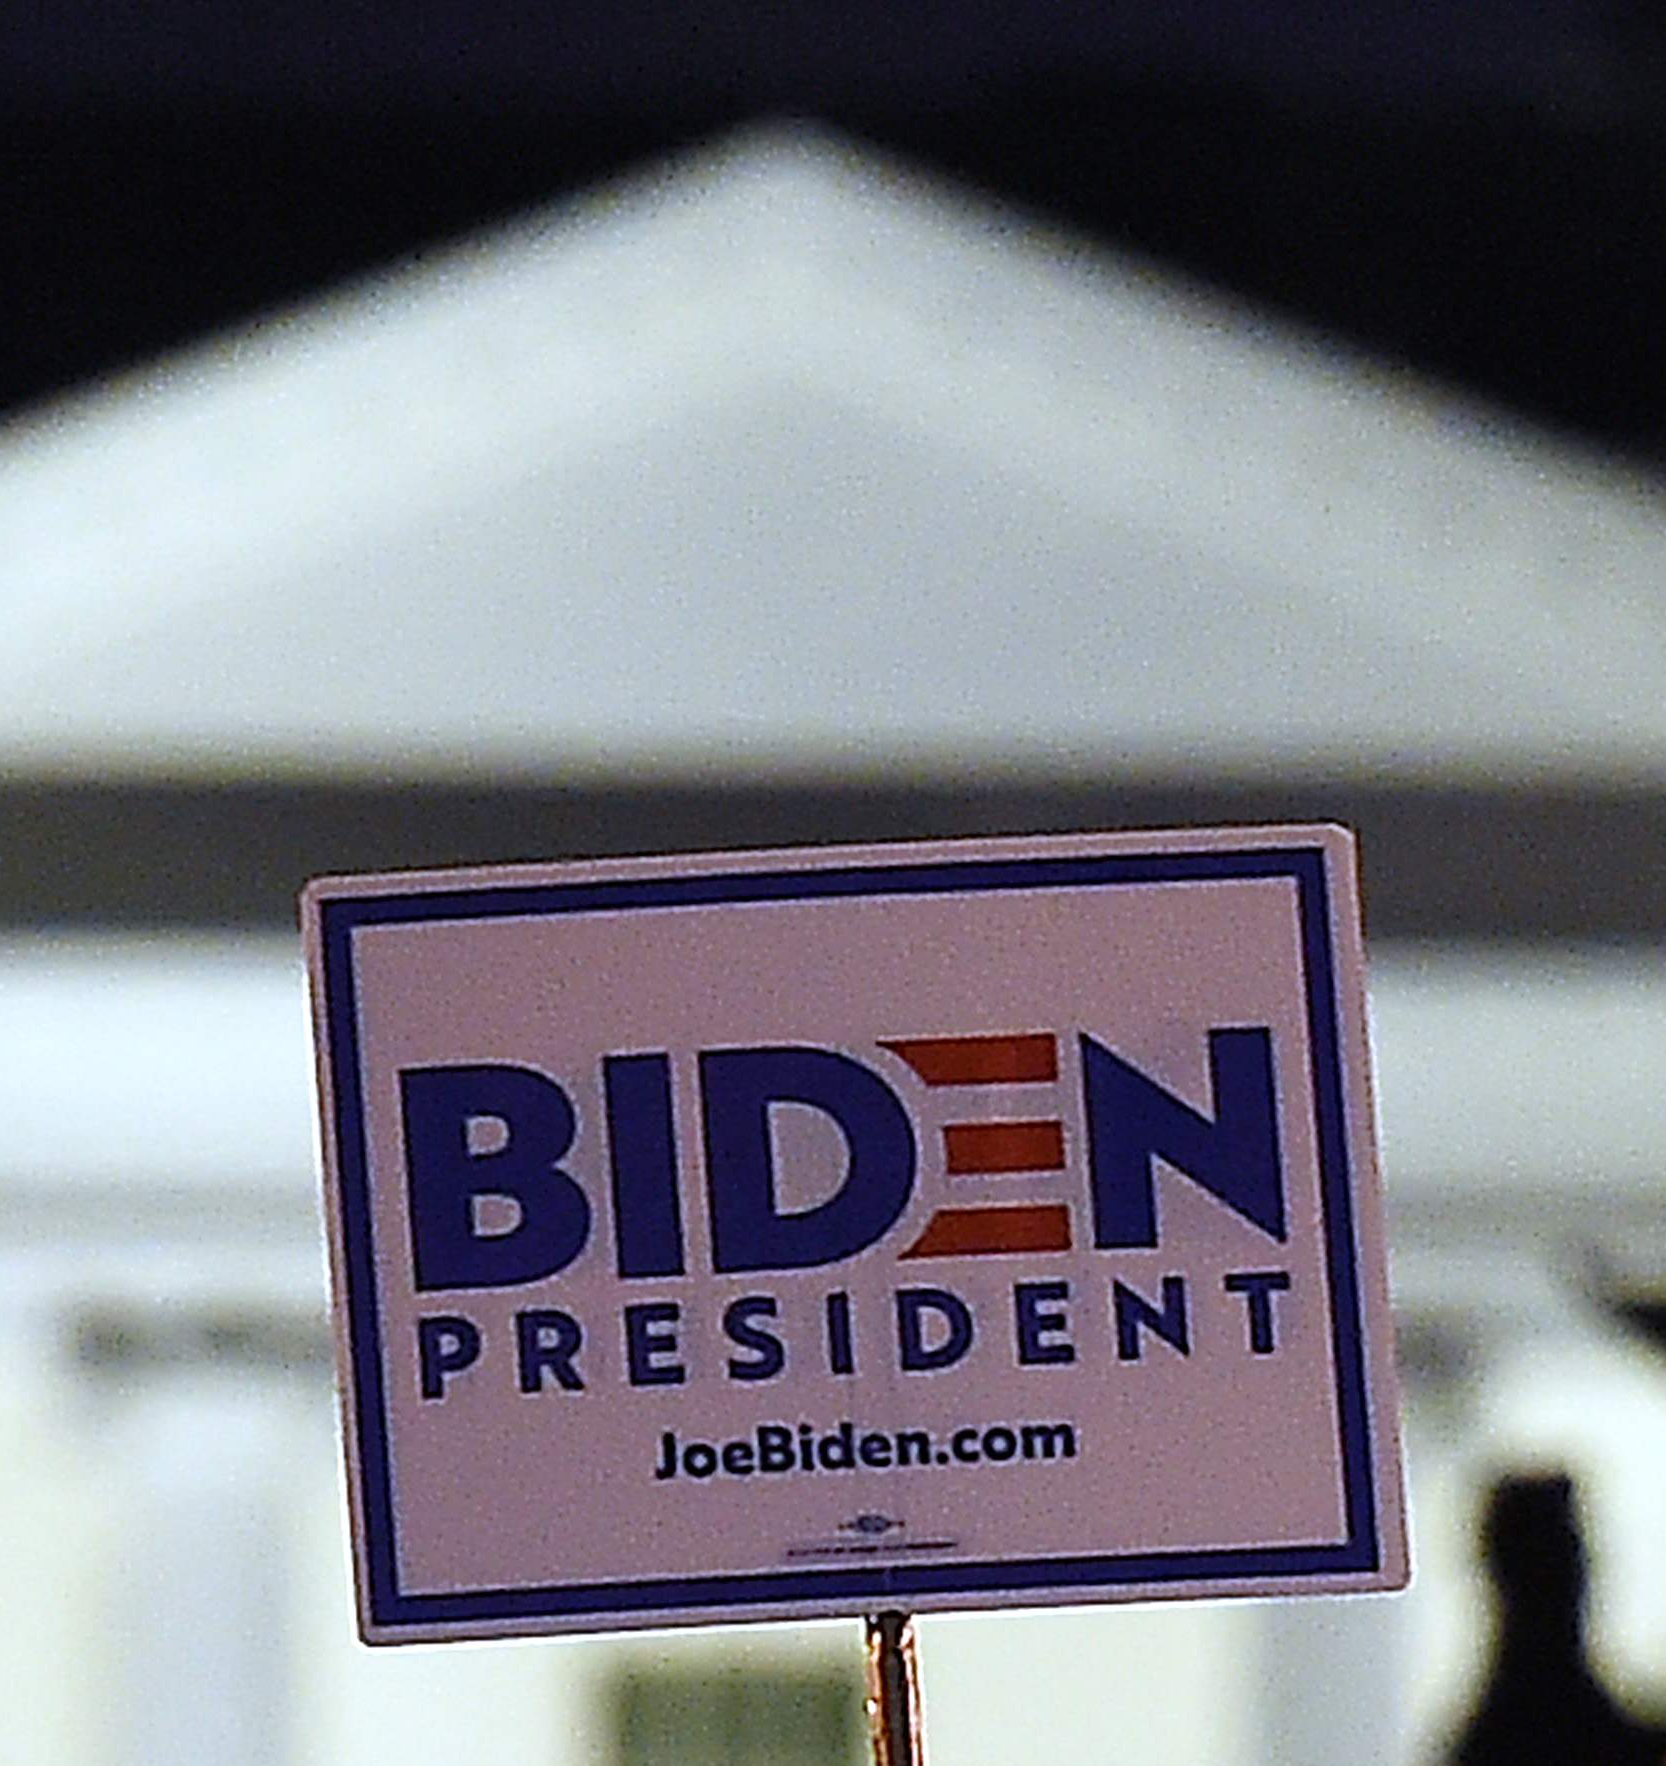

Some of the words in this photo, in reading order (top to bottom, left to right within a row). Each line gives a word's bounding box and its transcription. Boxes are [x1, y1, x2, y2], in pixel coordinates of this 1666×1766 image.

[397, 1025, 1288, 1293] BIDEN
[418, 1269, 1293, 1400] PRESIDENT
[653, 1421, 1079, 1481] JoeBiden.com
